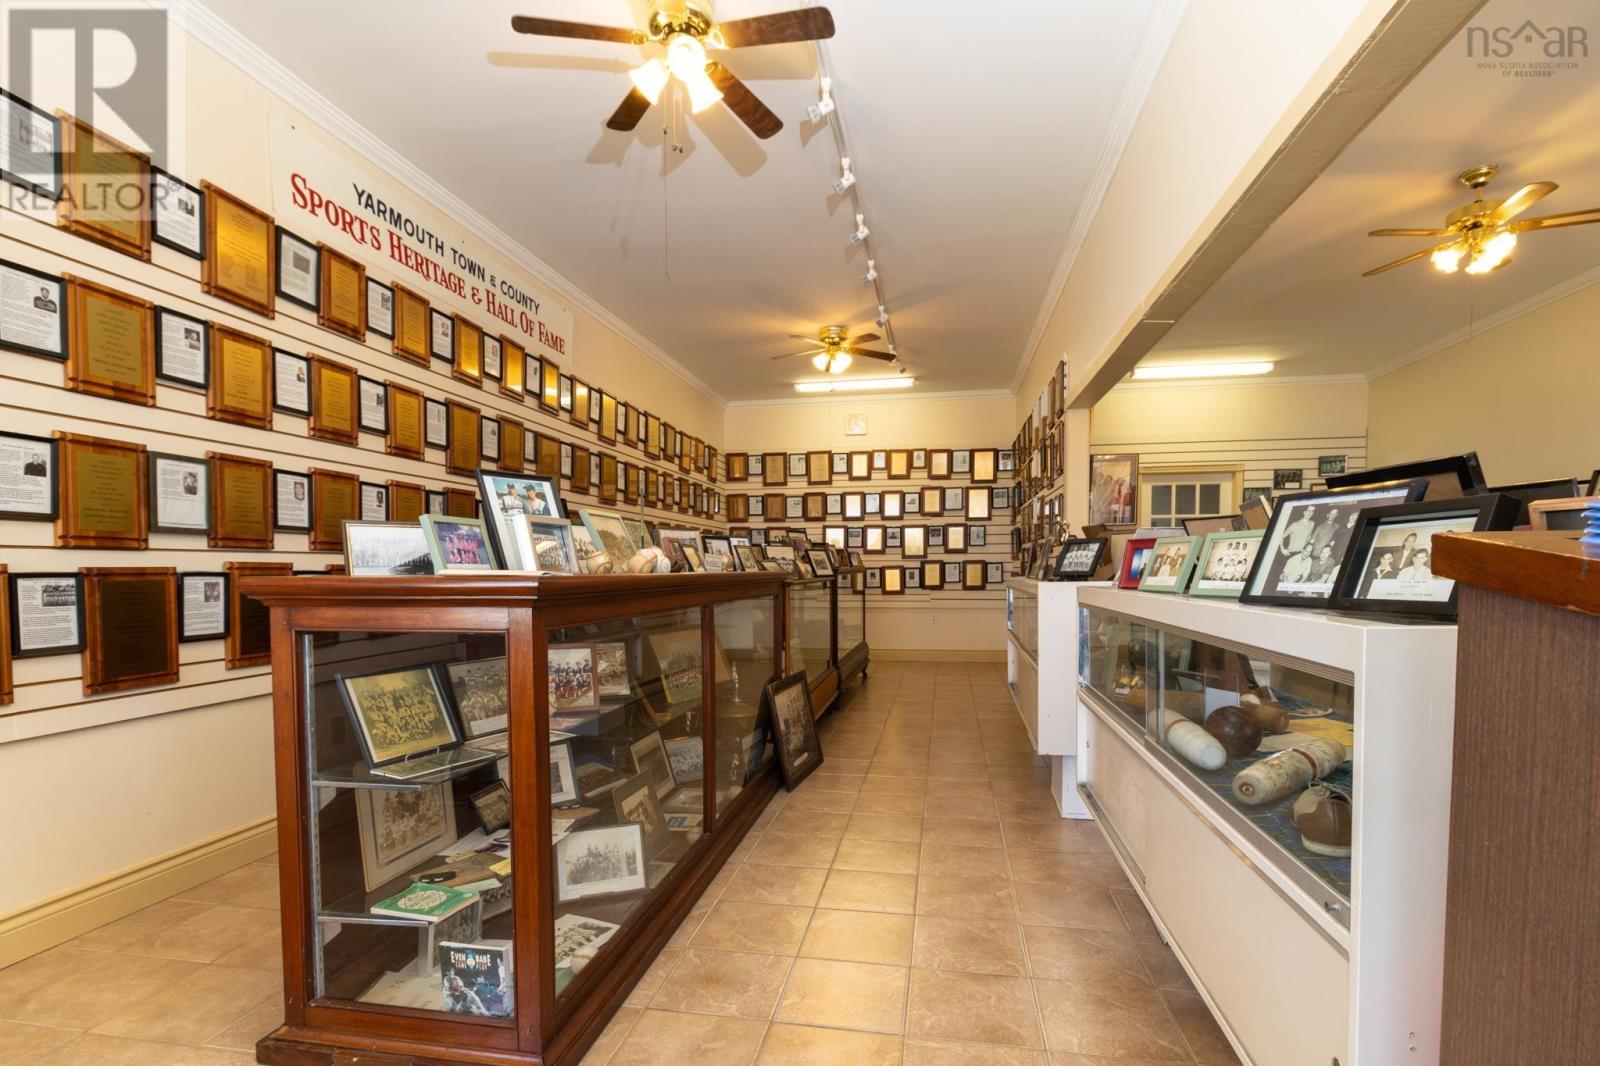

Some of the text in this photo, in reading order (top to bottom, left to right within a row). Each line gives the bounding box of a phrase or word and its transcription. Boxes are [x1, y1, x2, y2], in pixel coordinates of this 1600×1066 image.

[290, 172, 382, 251] SPORTS
[387, 229, 467, 300] HERITAGE
[471, 287, 482, 305] &
[485, 287, 517, 329] HALL
[538, 321, 565, 355] FAME
[352, 182, 444, 257] YARMOUTH
[450, 247, 486, 281] TOWN
[499, 280, 540, 315] COUNTY
